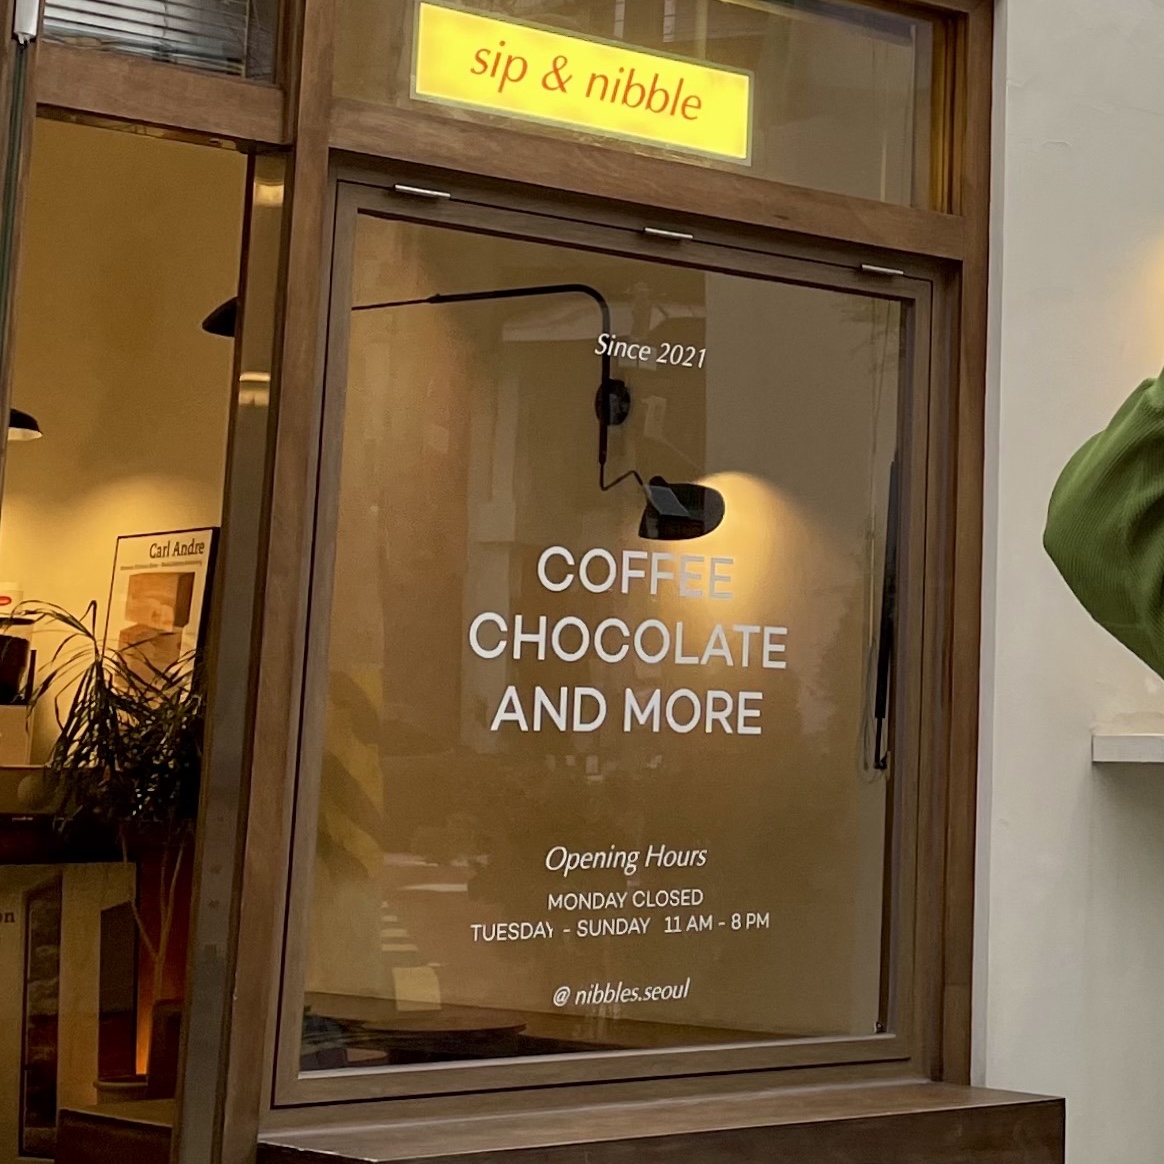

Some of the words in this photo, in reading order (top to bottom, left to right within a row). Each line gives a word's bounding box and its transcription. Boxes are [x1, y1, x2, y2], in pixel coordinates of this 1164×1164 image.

[470, 40, 529, 94] sip
[541, 54, 573, 94] &
[585, 66, 703, 121] nibble
[594, 332, 652, 361] Since
[655, 342, 707, 369] 2021
[149, 540, 171, 559] Carl
[172, 538, 205, 557] Andre
[537, 545, 735, 599] COFFEE
[469, 611, 788, 669] CHOCOLATE
[490, 685, 608, 732] AND
[623, 687, 763, 735] MORE
[545, 843, 641, 878] Opening
[644, 843, 708, 868] Hours
[547, 891, 628, 911] MONDAY
[632, 888, 704, 908] CLOSED
[470, 921, 554, 942] TUESDAY
[576, 917, 651, 938] SUNDAY
[663, 915, 683, 934] 11
[685, 914, 713, 932] AM
[731, 912, 742, 931] 8
[745, 912, 770, 930] PM
[552, 985, 572, 1008] @
[574, 976, 691, 1006] nibbles.seoul
